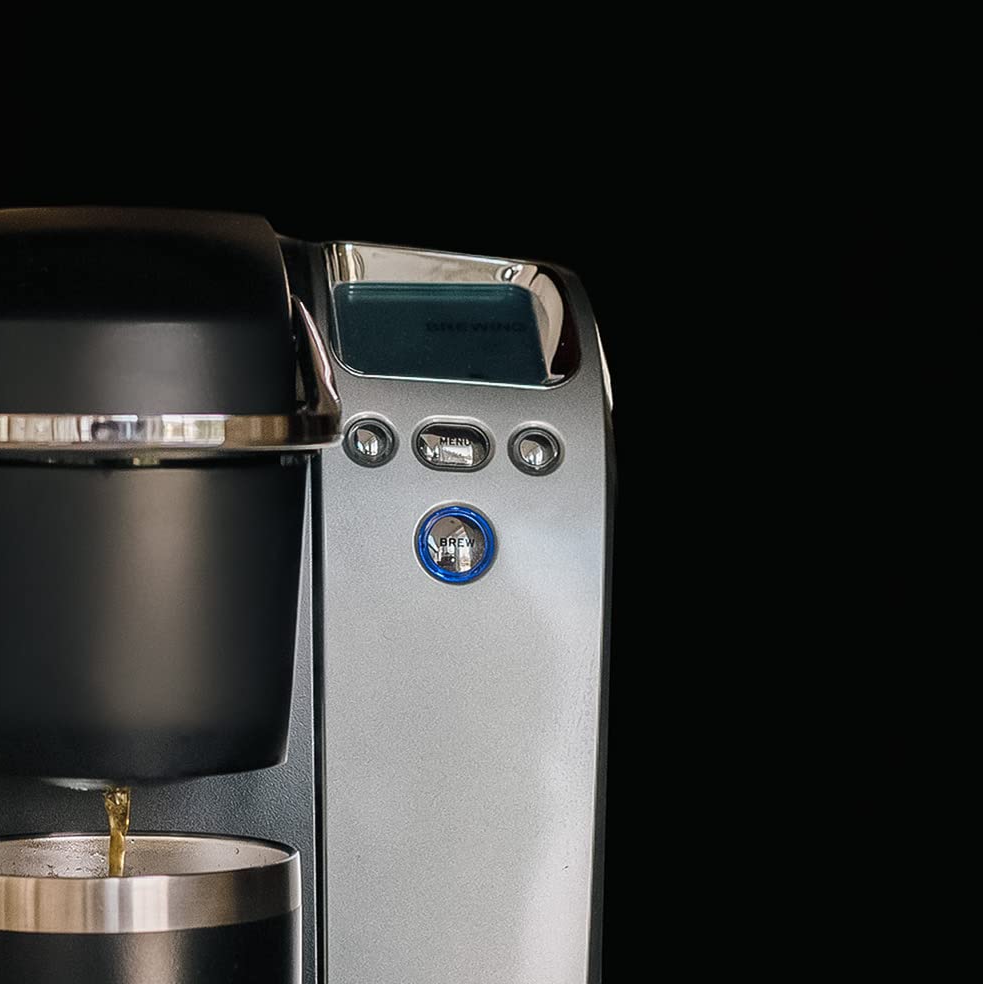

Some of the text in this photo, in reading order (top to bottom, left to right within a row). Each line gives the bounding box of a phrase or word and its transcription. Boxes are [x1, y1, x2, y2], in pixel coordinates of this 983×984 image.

[425, 321, 528, 333] BREWING
[439, 437, 471, 448] MENU
[439, 536, 475, 548] BREW
